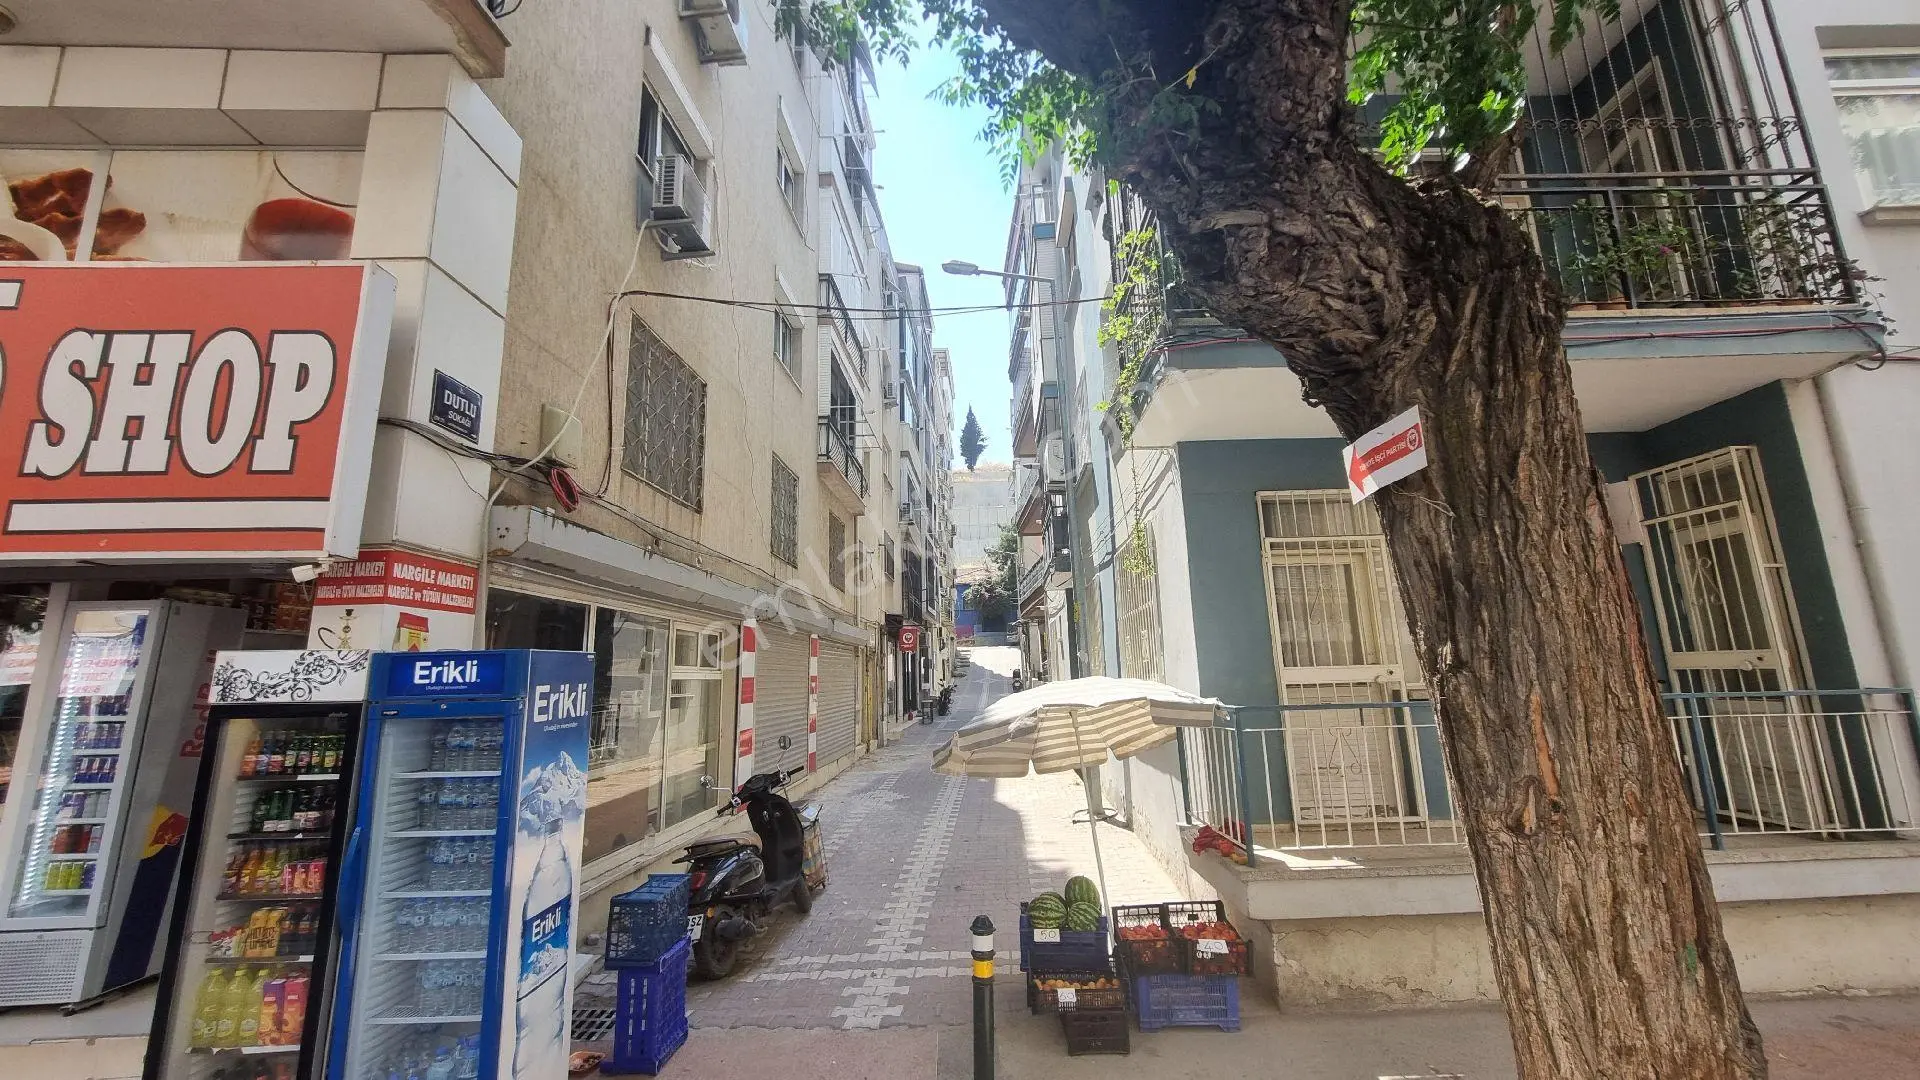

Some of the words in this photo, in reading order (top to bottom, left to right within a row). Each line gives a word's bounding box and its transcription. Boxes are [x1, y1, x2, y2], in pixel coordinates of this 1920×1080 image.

[18, 327, 337, 480] SHOP
[444, 389, 477, 418] DUTLU
[393, 563, 435, 584] NARGİLE
[436, 570, 474, 591] MARKETİ
[387, 584, 414, 600] NARGİLE
[413, 660, 478, 685] Erikli
[533, 682, 588, 723] Erikli
[531, 906, 562, 943] Erikli
[1039, 929, 1057, 940] 50
[1203, 941, 1224, 952] 40
[1059, 991, 1075, 1001] 60
